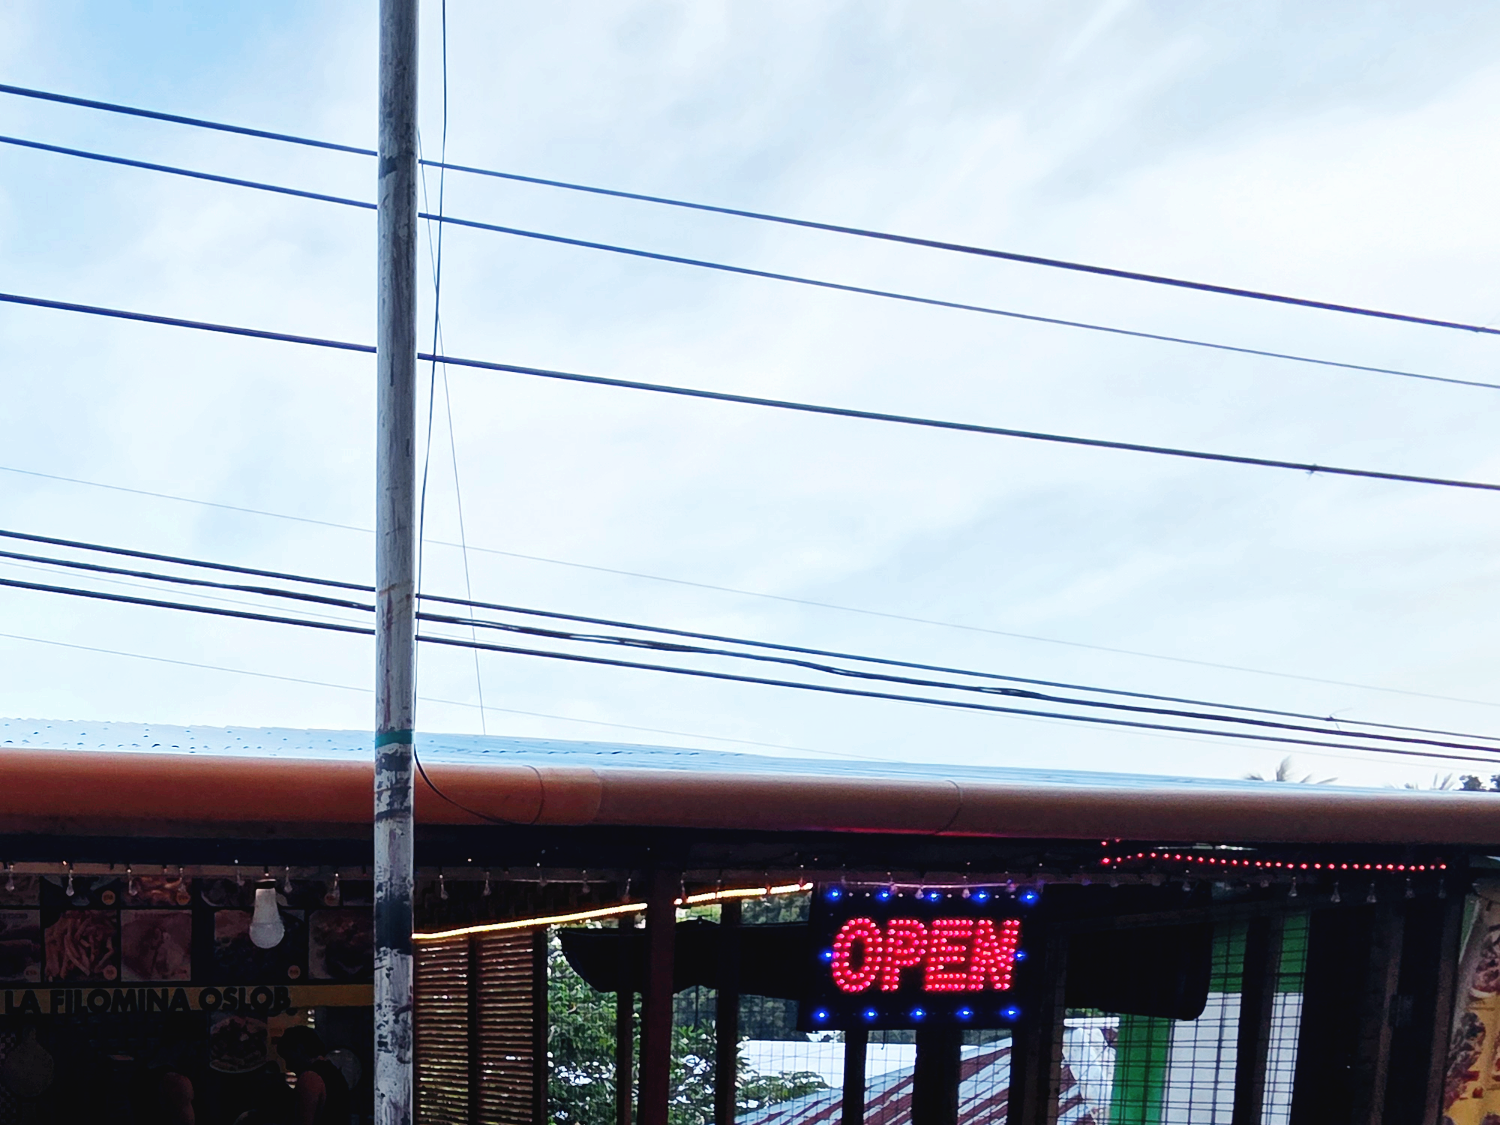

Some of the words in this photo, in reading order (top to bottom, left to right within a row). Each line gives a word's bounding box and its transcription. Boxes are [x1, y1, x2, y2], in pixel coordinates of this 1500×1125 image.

[830, 916, 1022, 993] OPEN
[4, 989, 42, 1015] LA
[50, 987, 192, 1013] FILOMINA
[198, 985, 292, 1012] OSLOB
